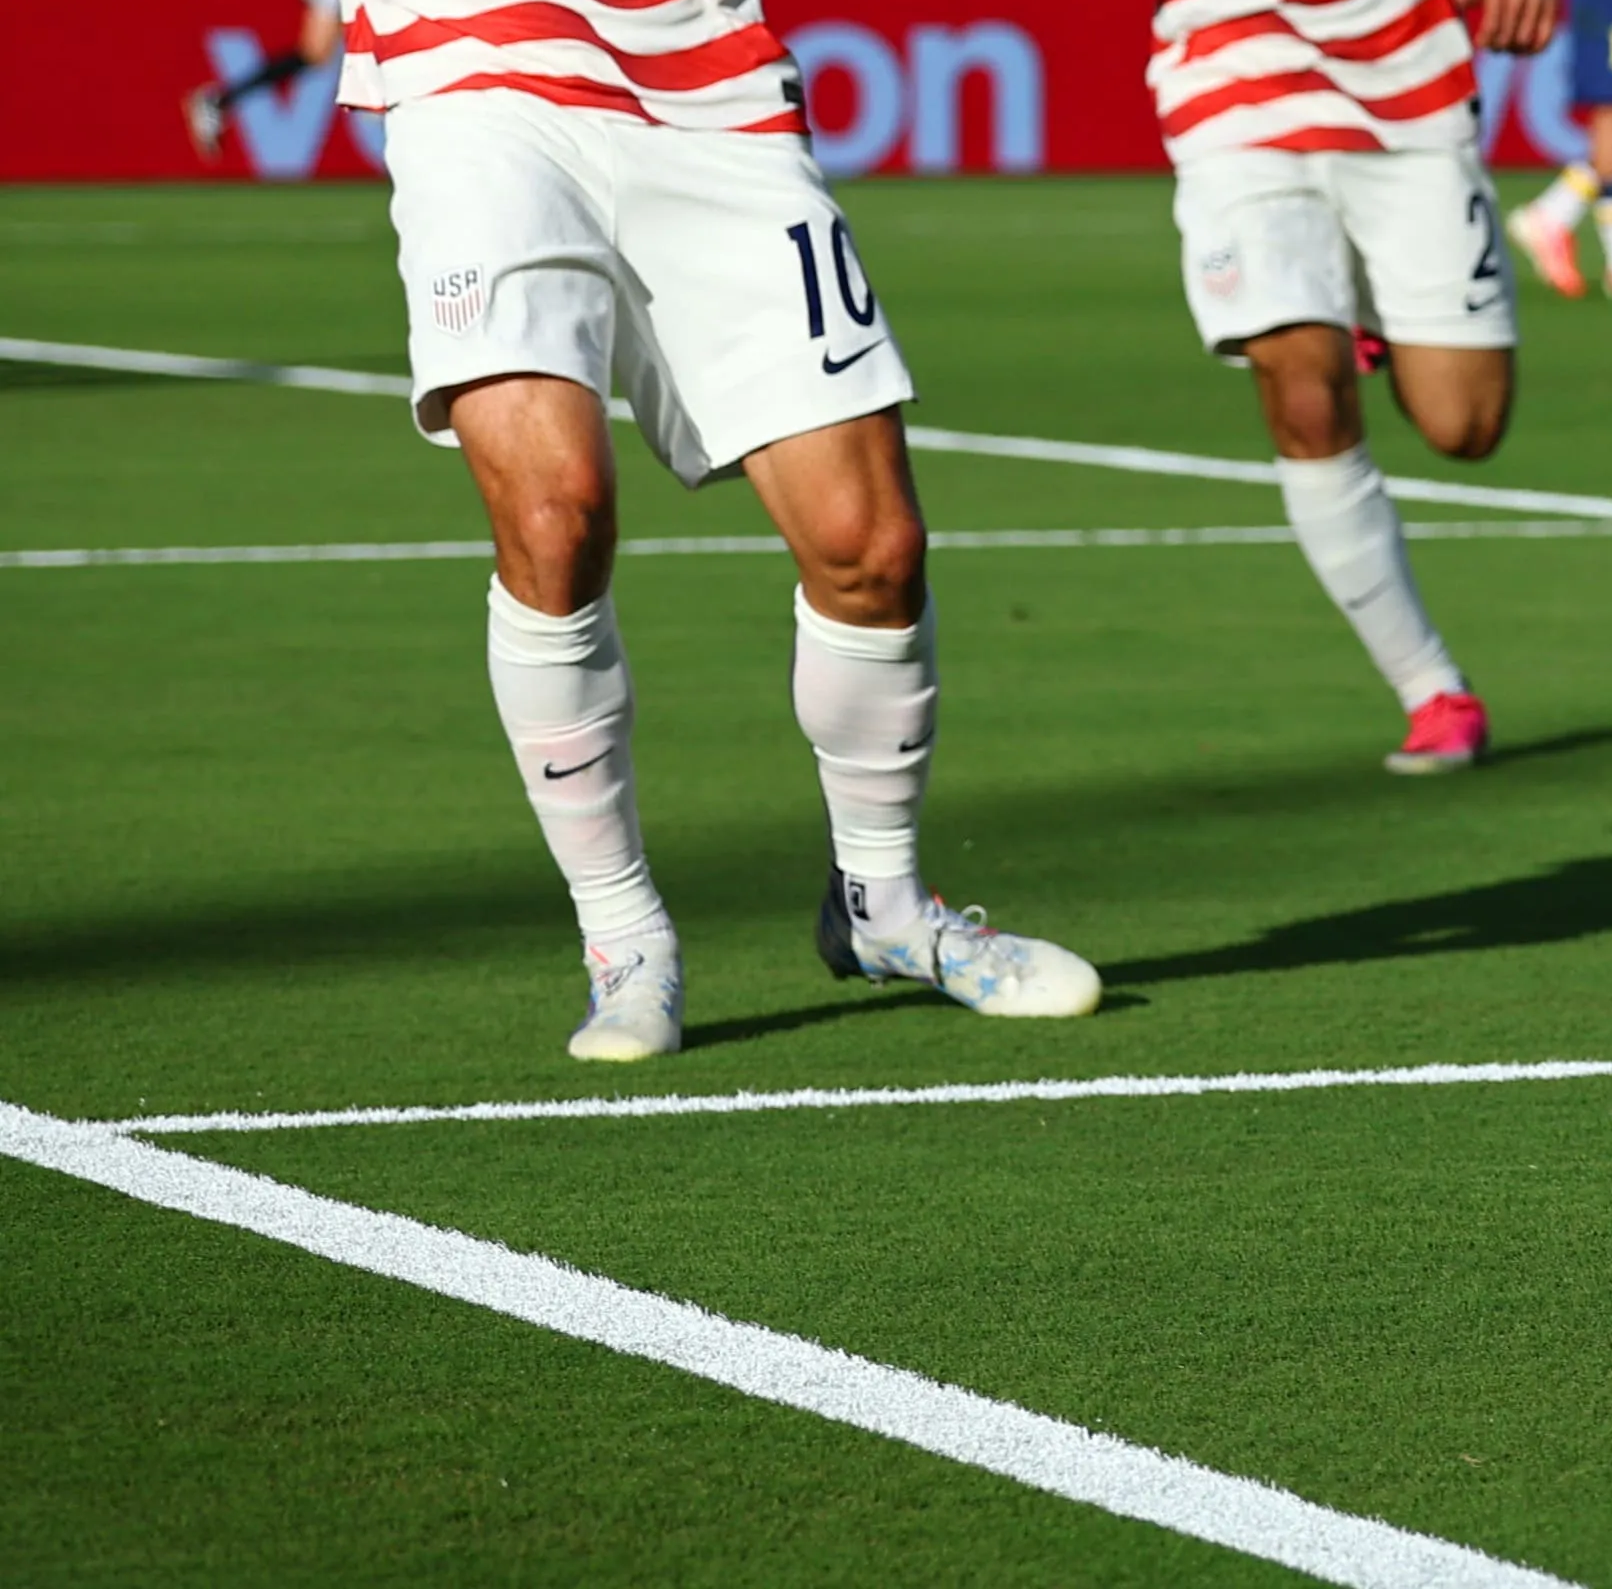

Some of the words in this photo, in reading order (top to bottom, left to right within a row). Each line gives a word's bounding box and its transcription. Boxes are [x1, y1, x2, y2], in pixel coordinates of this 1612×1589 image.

[787, 216, 877, 339] 10
[1467, 190, 1498, 279] 2
[433, 269, 478, 298] USA
